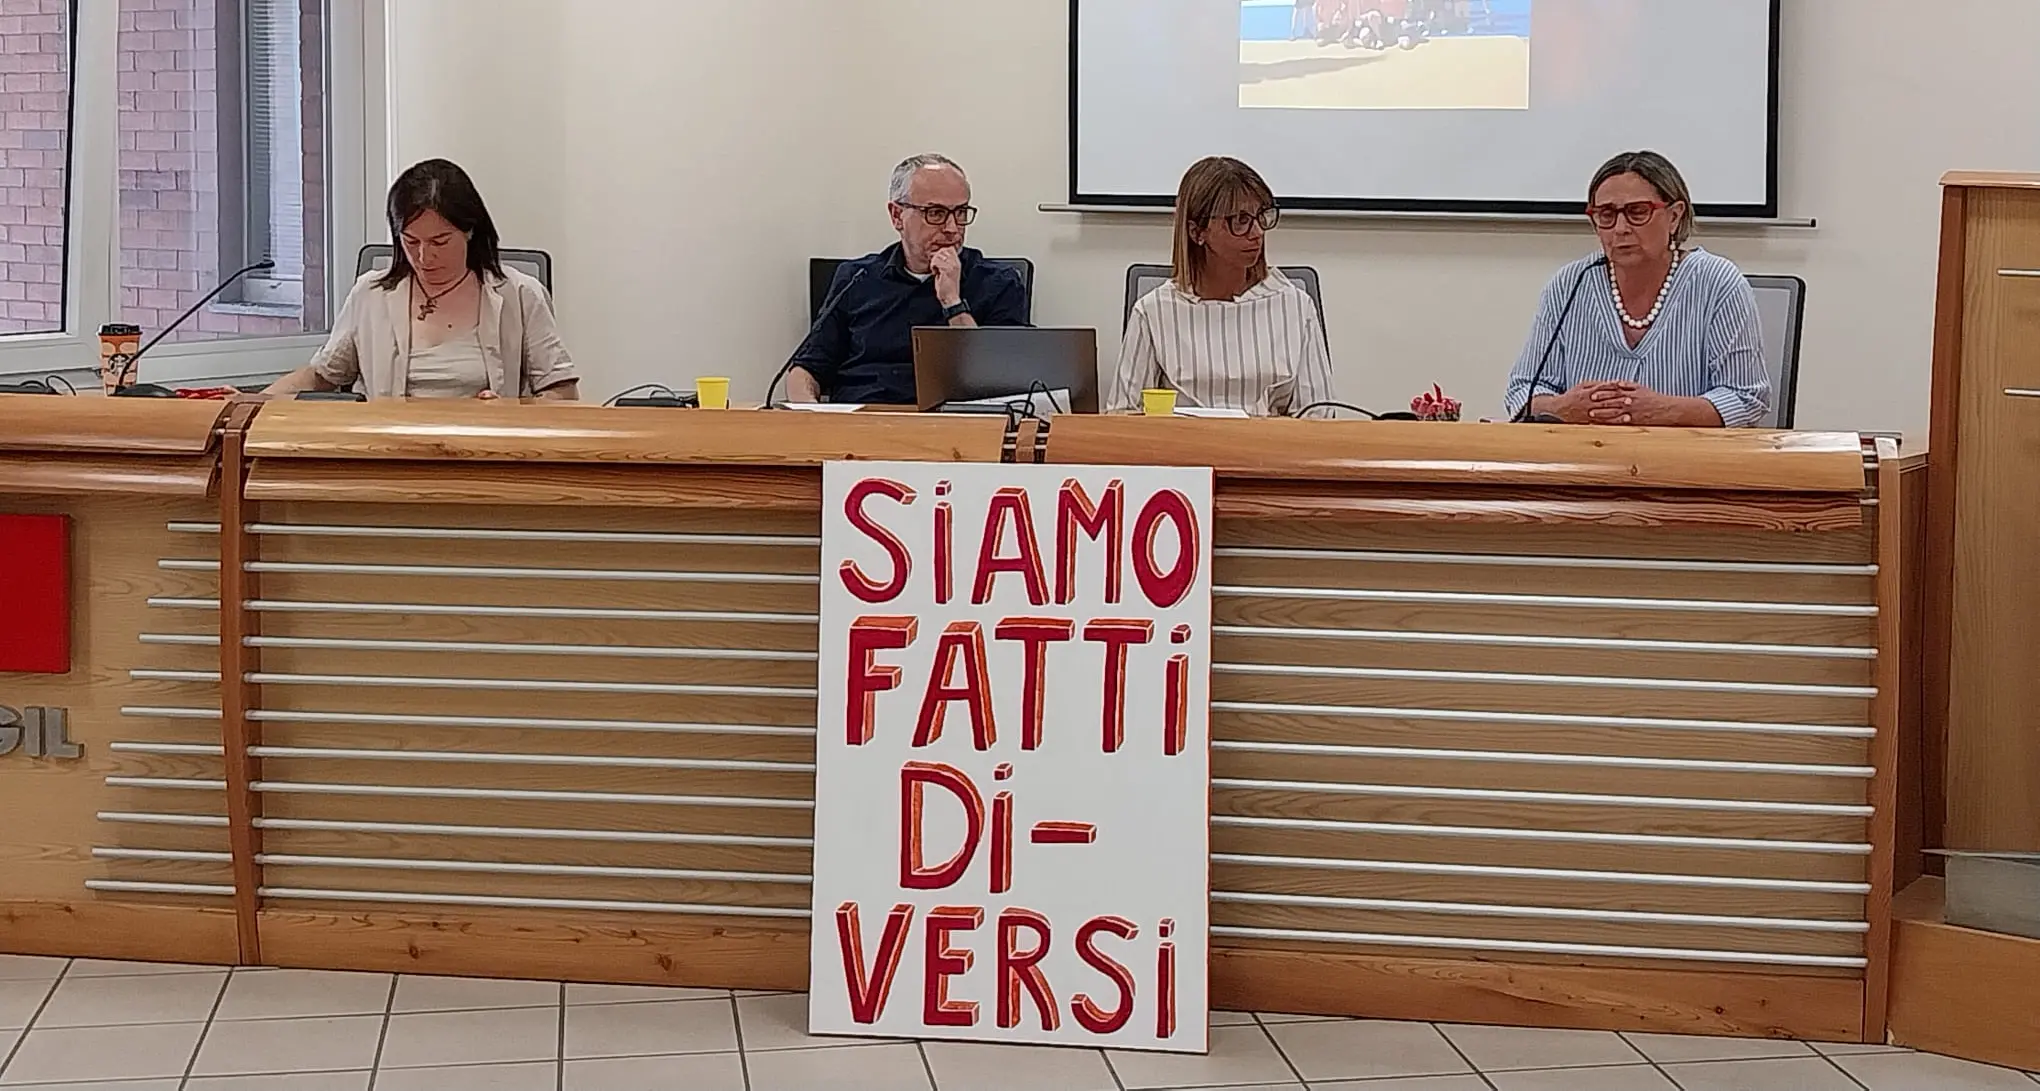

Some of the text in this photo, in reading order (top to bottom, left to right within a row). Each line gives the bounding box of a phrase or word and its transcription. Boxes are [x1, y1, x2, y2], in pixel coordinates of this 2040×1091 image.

[839, 478, 1200, 608] SiAMO
[846, 616, 1191, 756] FATTi
[899, 760, 1097, 893] Di-
[835, 902, 1176, 1039] VERSi
